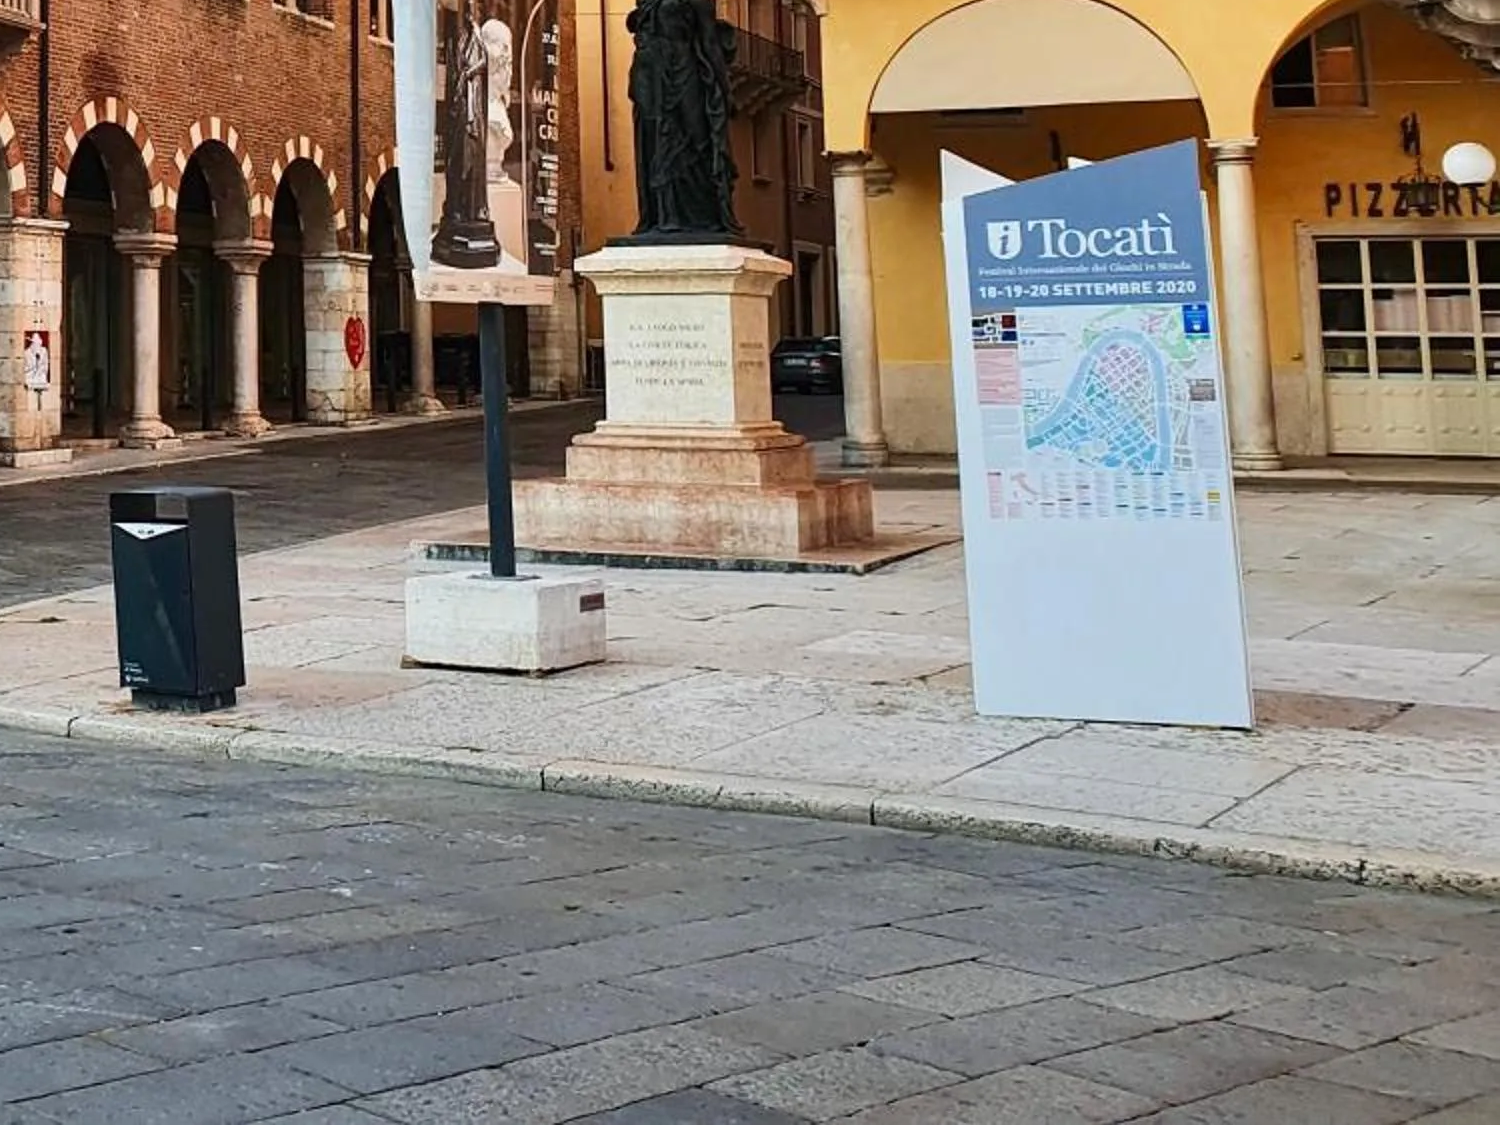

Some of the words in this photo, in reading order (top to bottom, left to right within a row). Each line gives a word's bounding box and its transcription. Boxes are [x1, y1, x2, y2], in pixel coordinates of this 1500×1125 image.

[1324, 181, 1500, 218] PIZZRIA
[1027, 213, 1178, 259] Tocatì
[978, 266, 1015, 276] Festival
[979, 285, 1049, 299] 18-19-20
[1052, 281, 1153, 296] SETTEMBRE
[1155, 280, 1197, 294] 2020
